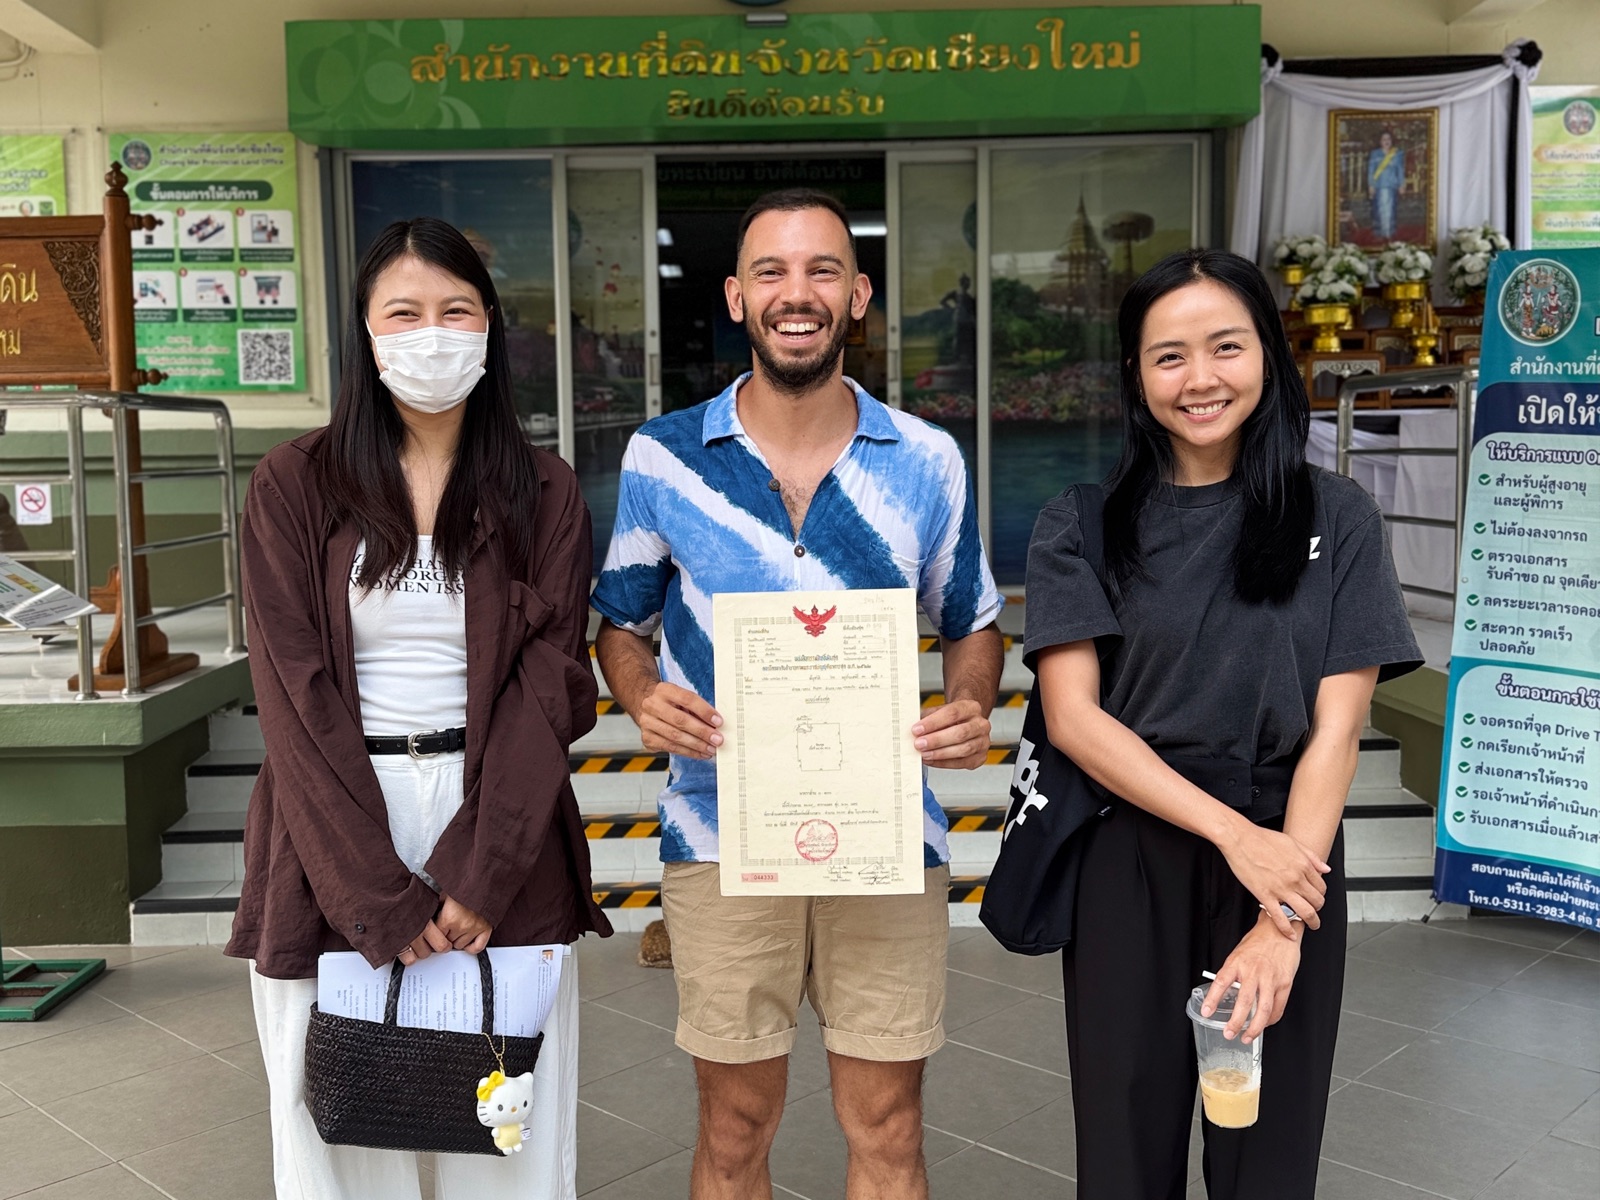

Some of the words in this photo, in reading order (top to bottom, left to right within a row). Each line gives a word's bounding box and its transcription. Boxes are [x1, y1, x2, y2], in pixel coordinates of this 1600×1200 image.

[410, 18, 1142, 83] สำนักงานที่ดินจังหวัดเชียงใหม่
[666, 87, 885, 120] ยินดีต้อนรับ
[1510, 350, 1600, 376] สำนักงานที่
[1518, 392, 1600, 426] เปิดให้
[1495, 474, 1587, 497] สำหรับผู้สูงอายุ
[1493, 494, 1564, 512] และผู้พิการ
[1490, 519, 1588, 542] ไม่ต้องลงจากรถ
[1488, 551, 1568, 568] ตรวจเอกสาร
[1486, 566, 1539, 584] รับคำขอ
[1542, 574, 1556, 586] ณ
[1481, 621, 1525, 637] สะดวก
[1528, 626, 1573, 642] รวดเร็ว
[1479, 639, 1536, 656] ปลอดภัย
[1495, 673, 1600, 710] ขั้นตอนการใช้
[1479, 714, 1551, 738] จอดรถที่จุด
[1555, 724, 1590, 740] Drive
[1477, 739, 1586, 765] กดเรียกเจ้าหน้าที่
[1474, 762, 1589, 791] ส่งเอกสารให้ตรวจ
[1469, 809, 1600, 845] รับเอกสารเมื่อแล้วเส
[1468, 889, 1576, 923] โทร.0-5311-2983-4
